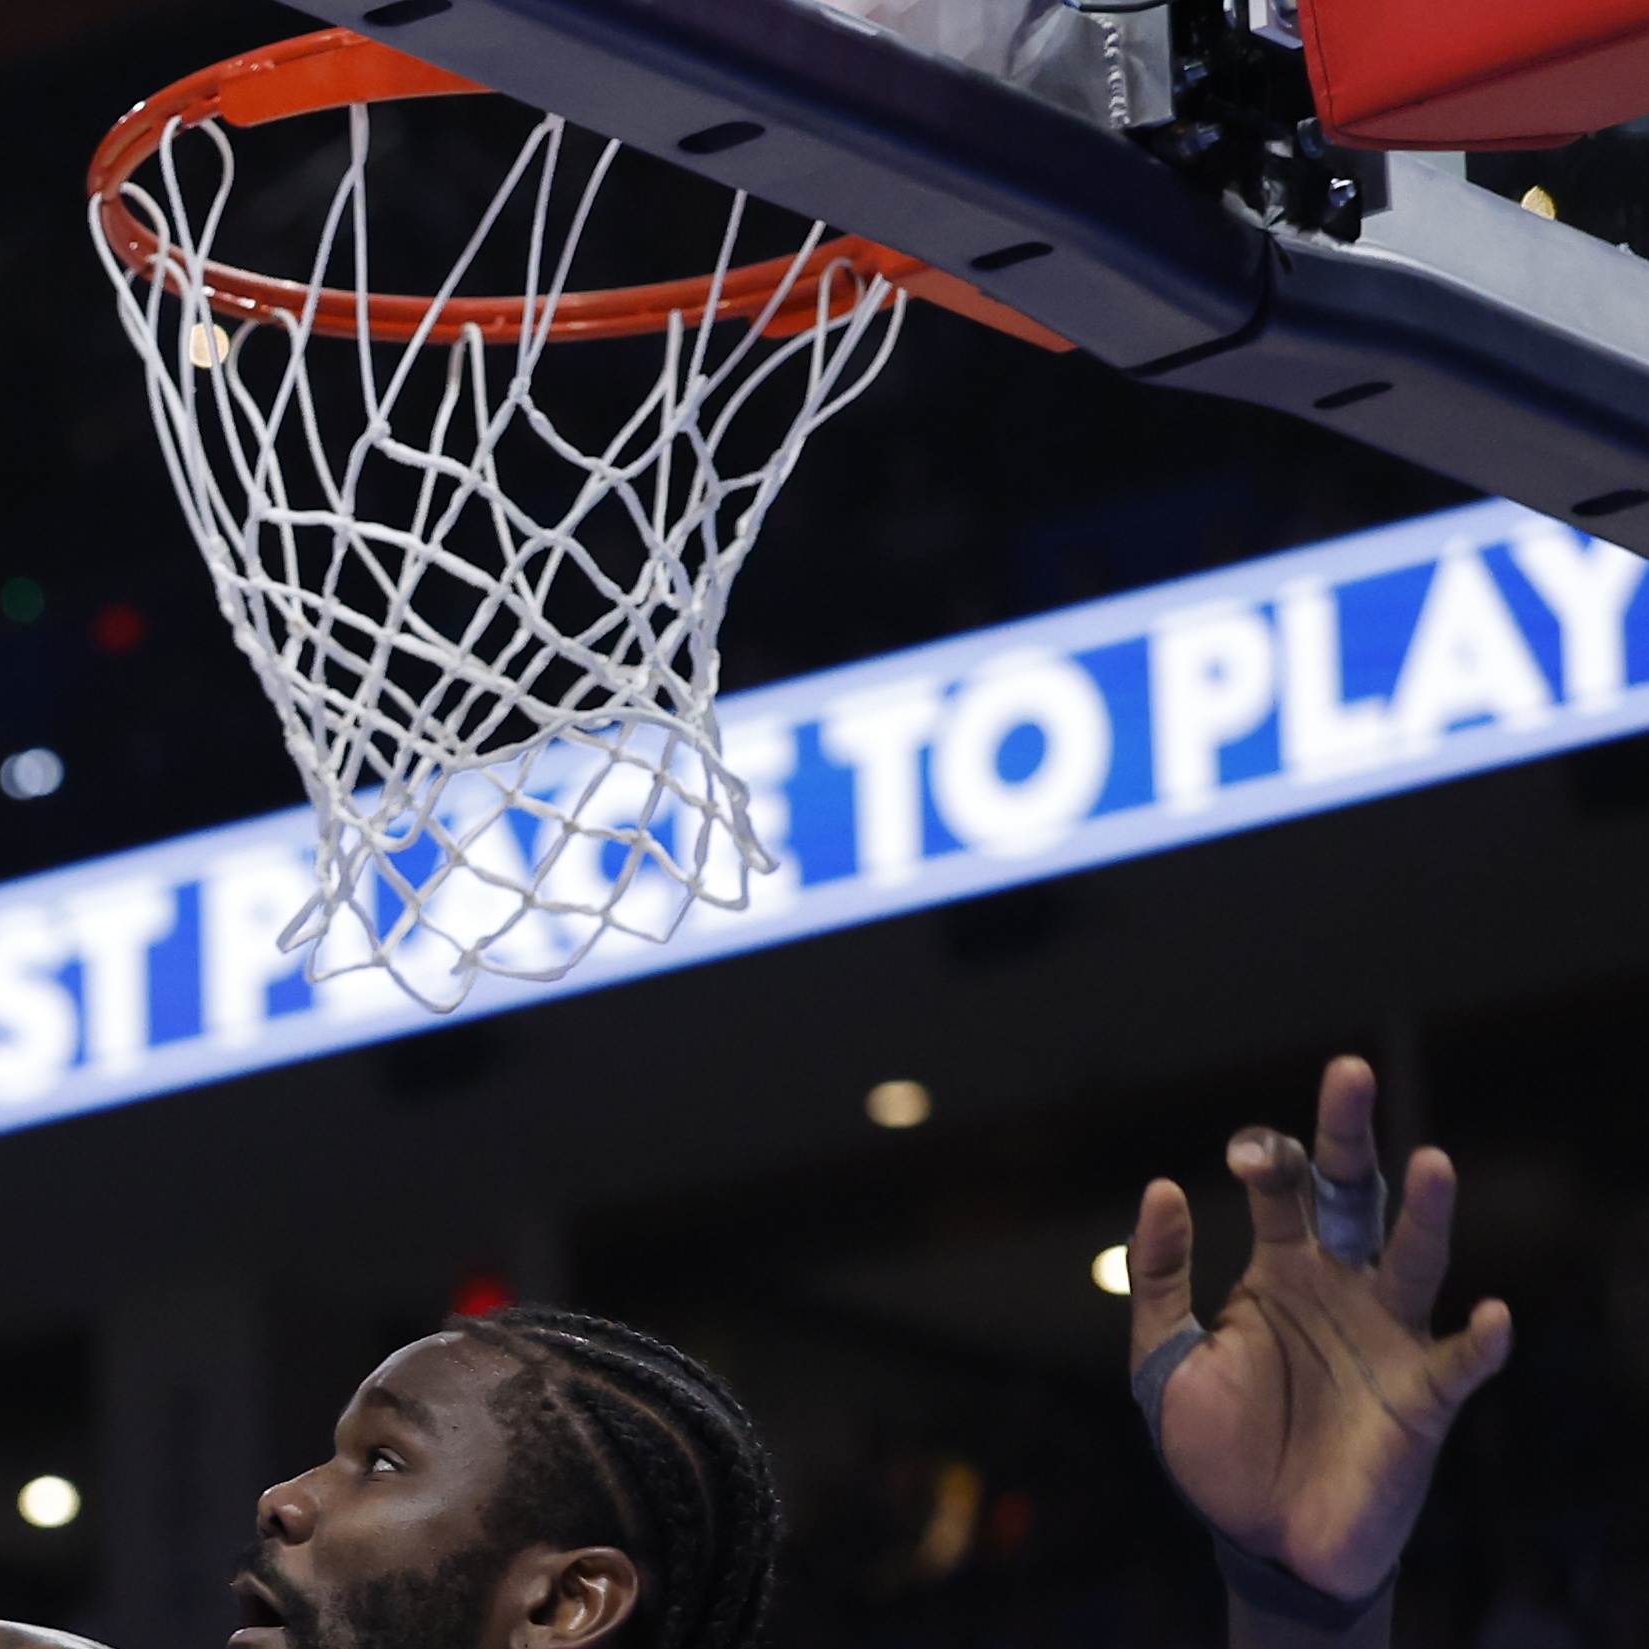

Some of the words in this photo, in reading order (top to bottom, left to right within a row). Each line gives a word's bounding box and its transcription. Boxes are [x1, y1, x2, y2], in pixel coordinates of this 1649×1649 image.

[200, 715, 794, 1052] PLACE
[819, 640, 1114, 890] TO
[1142, 512, 1646, 815] PLAY
